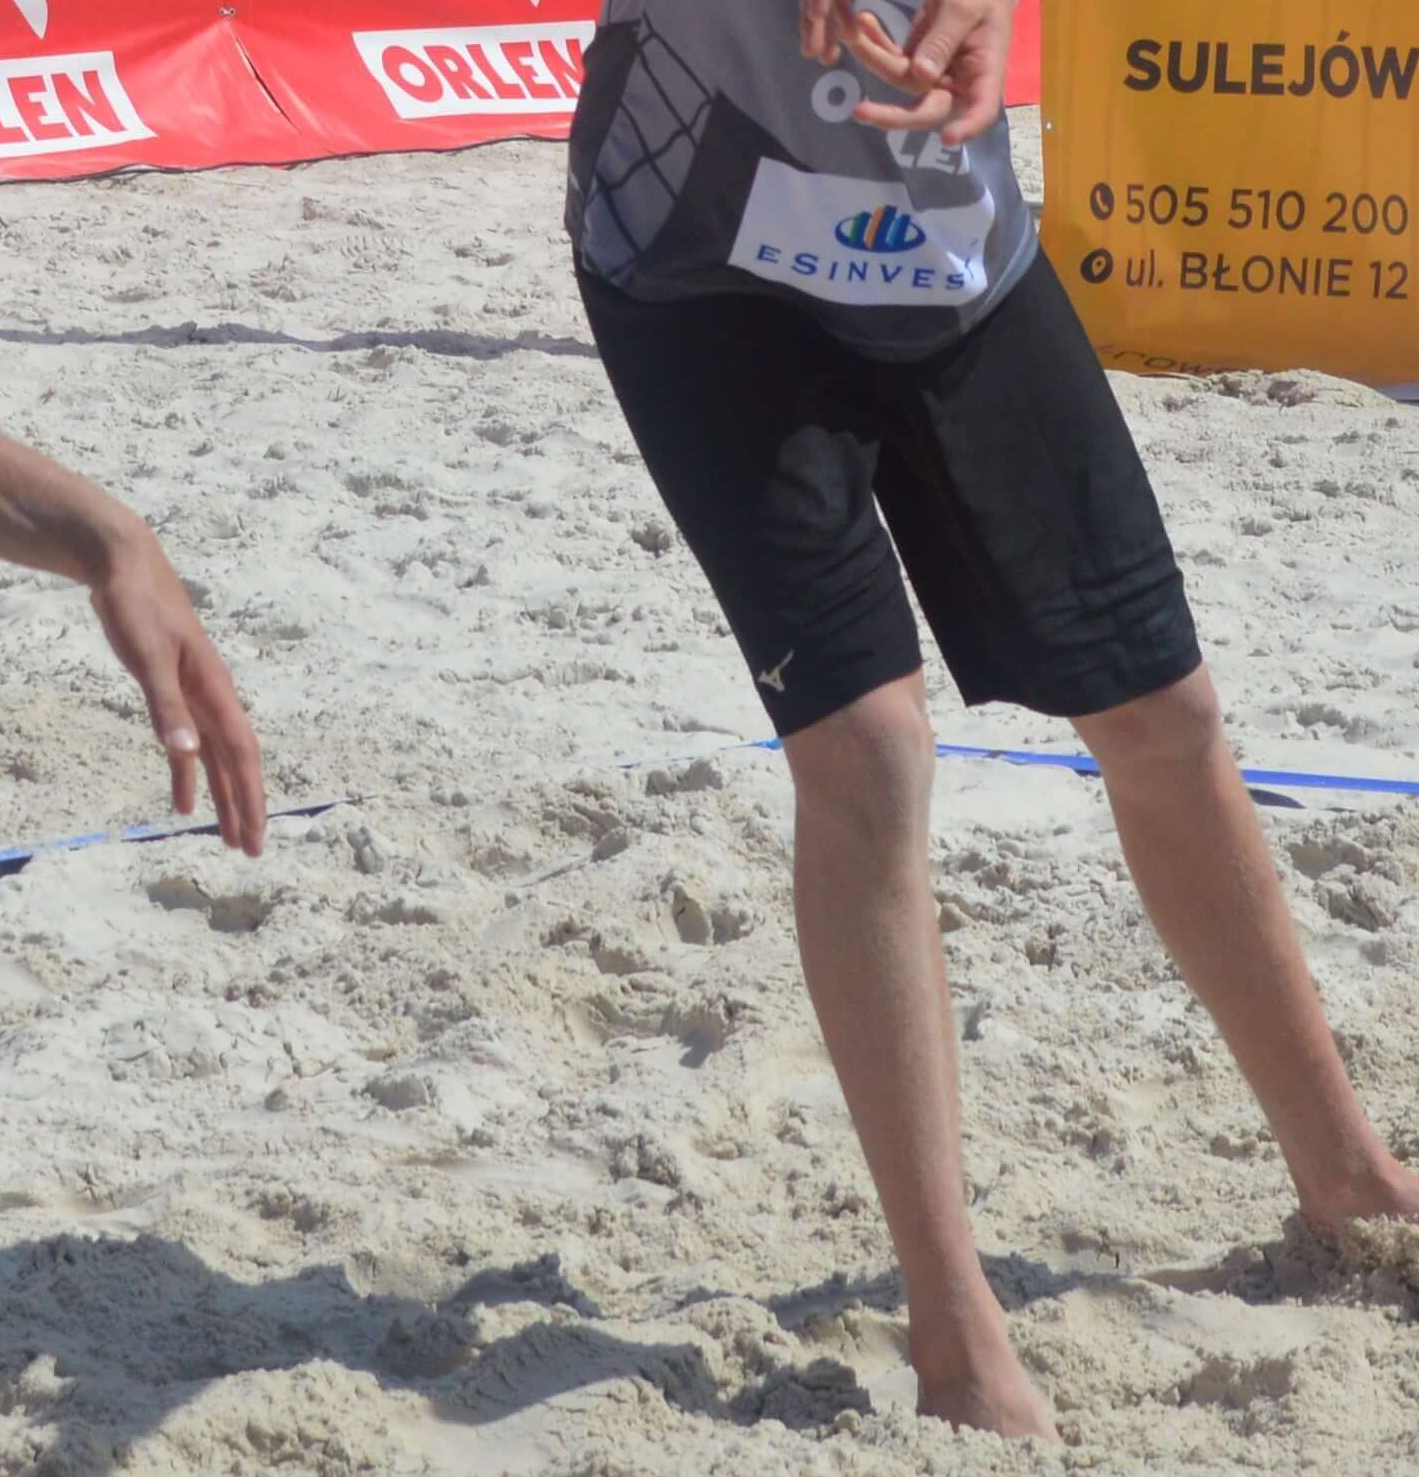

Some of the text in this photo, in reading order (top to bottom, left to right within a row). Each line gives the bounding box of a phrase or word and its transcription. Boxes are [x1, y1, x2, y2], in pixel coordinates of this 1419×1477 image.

[382, 38, 586, 103] ORLEN
[1125, 183, 1408, 236] 505 510 200
[1125, 249, 1408, 299] ul. BŁONIE 12
